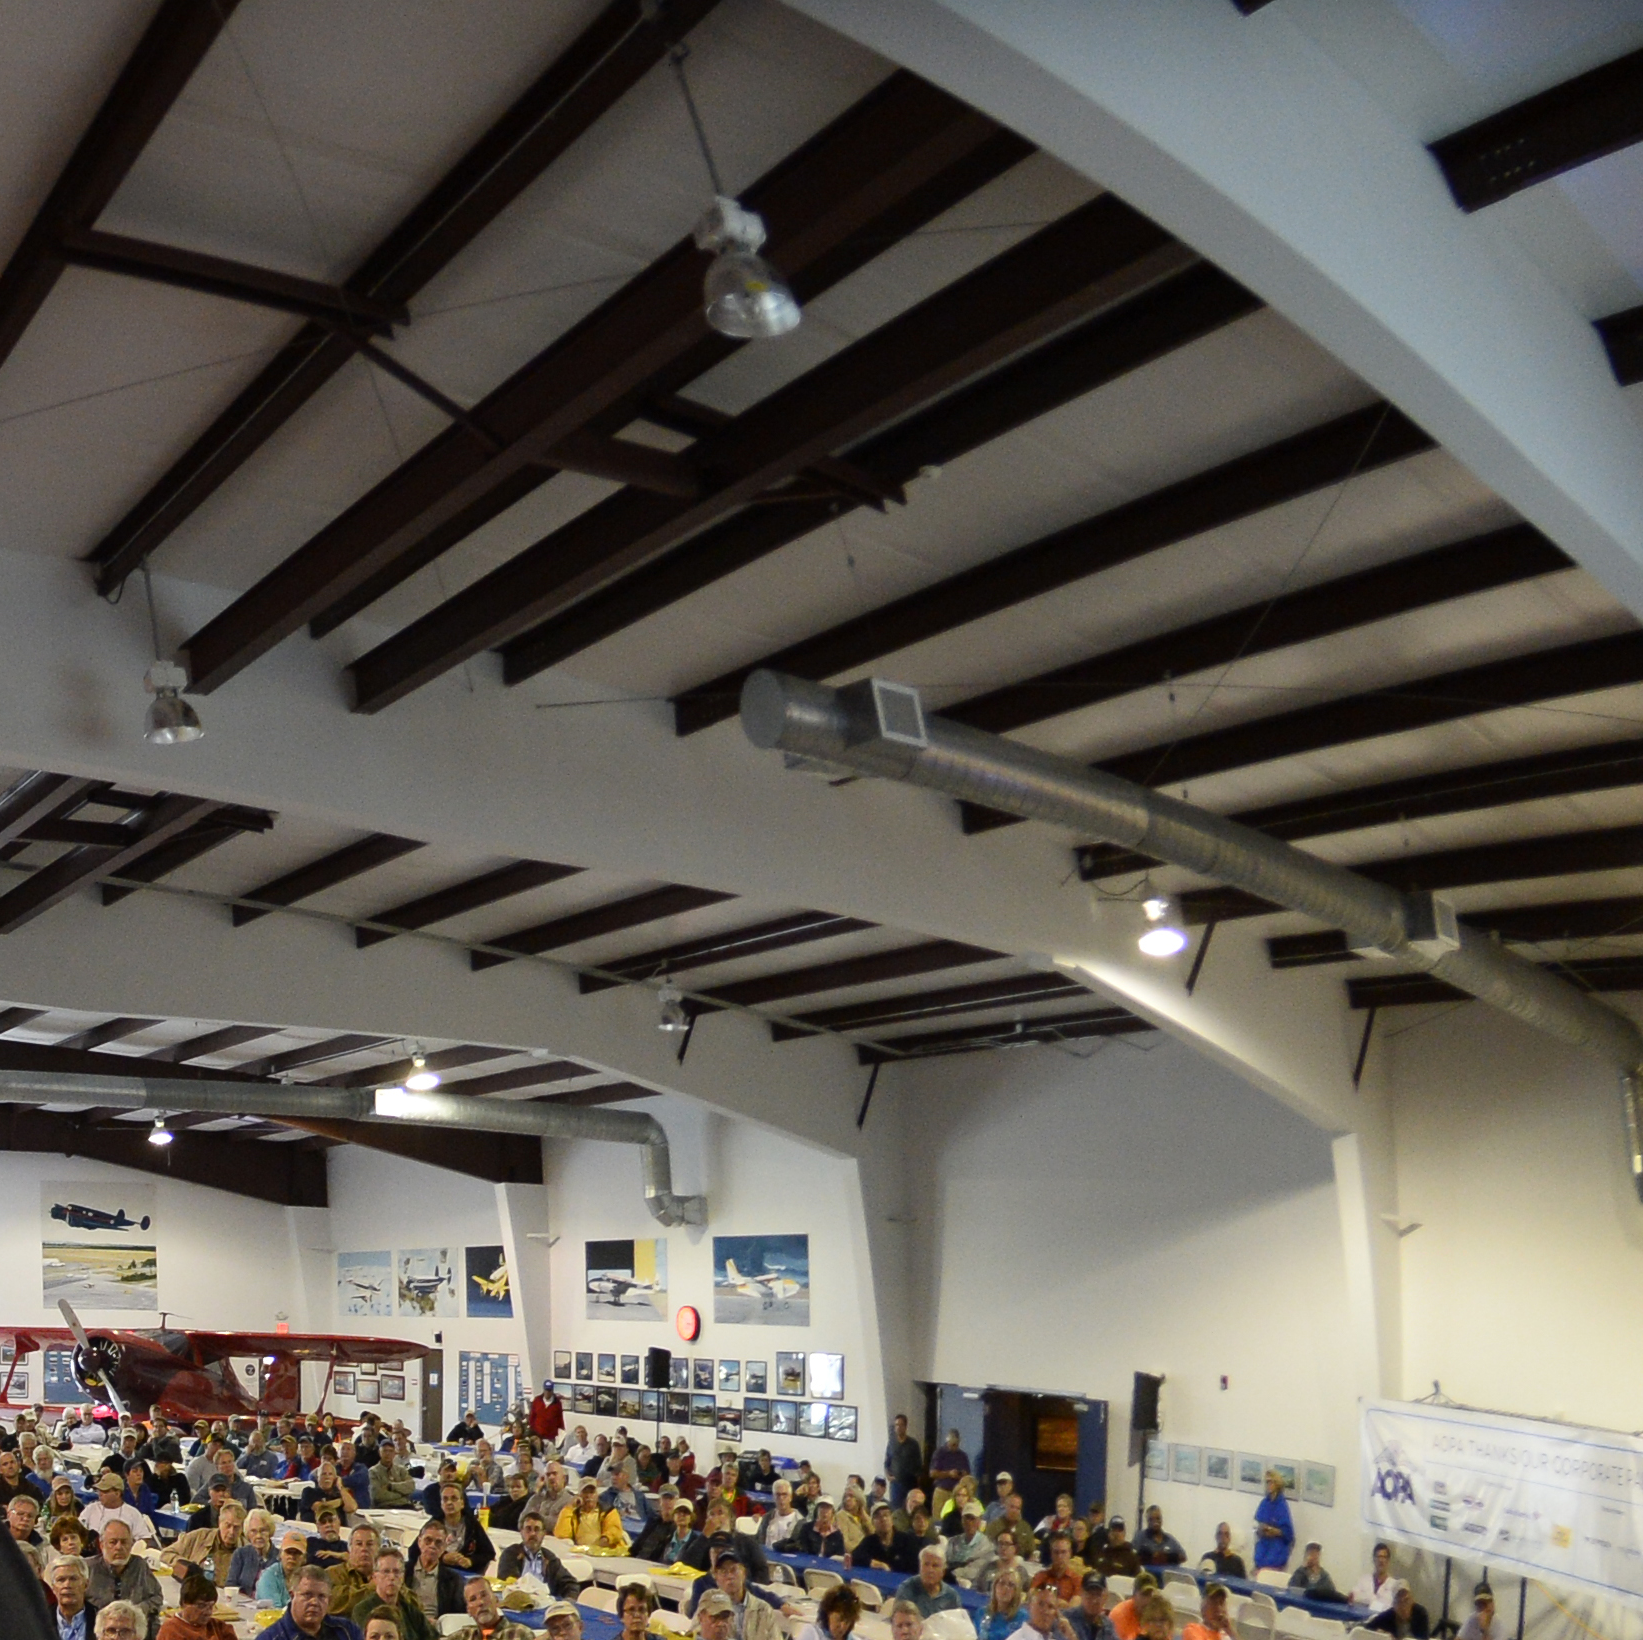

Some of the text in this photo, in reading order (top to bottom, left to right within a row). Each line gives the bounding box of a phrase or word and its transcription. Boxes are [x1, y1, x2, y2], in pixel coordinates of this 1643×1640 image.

[1370, 1467, 1417, 1505] AOPA
[1522, 1449, 1549, 1470] OUR
[1553, 1455, 1624, 1487] CORPORATE
